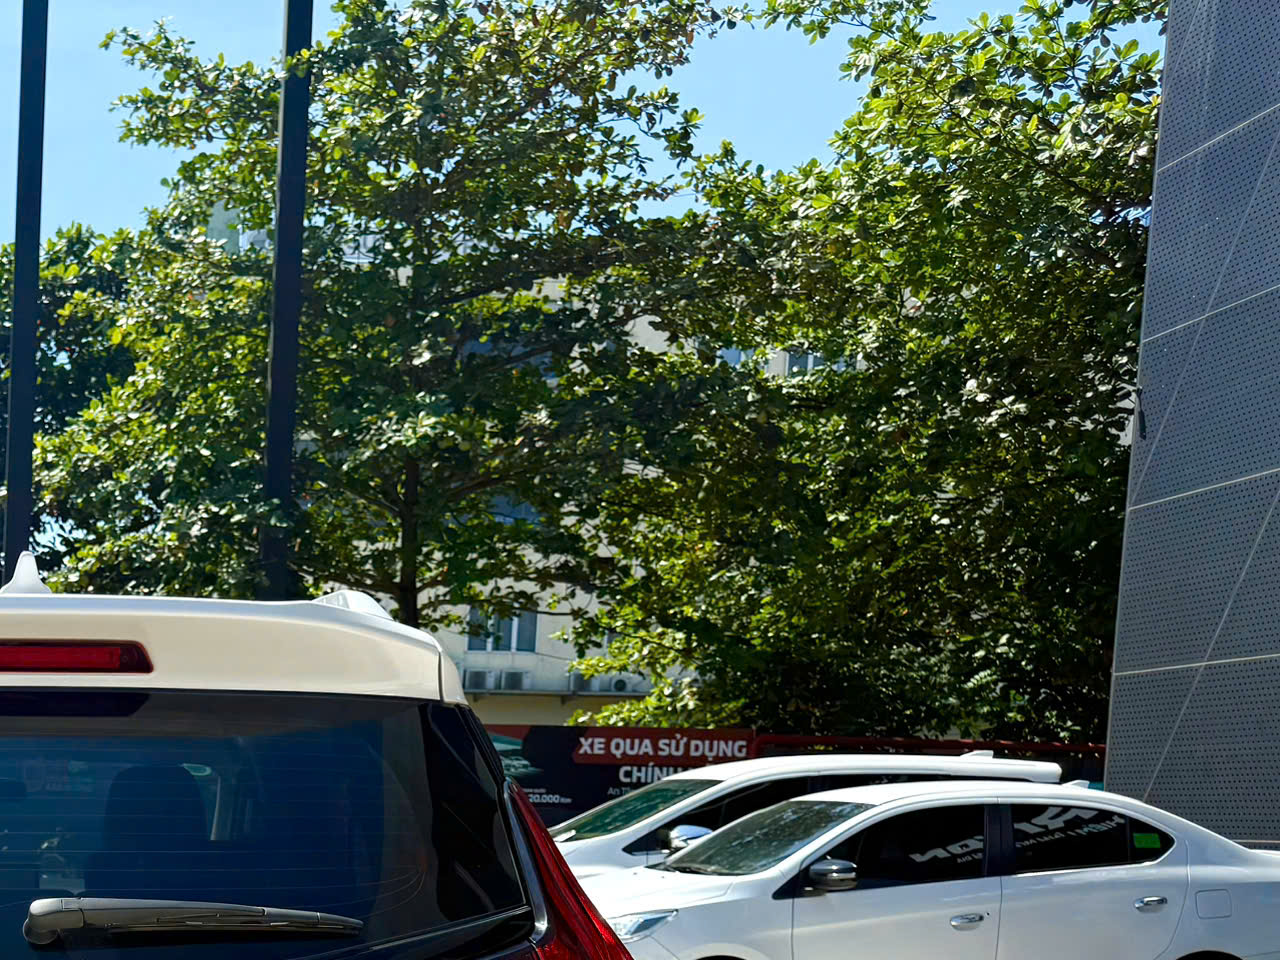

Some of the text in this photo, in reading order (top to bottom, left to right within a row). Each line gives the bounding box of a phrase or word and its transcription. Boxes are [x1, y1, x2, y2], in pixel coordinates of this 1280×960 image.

[578, 733, 748, 762] XE QUA SỬ DỤNG
